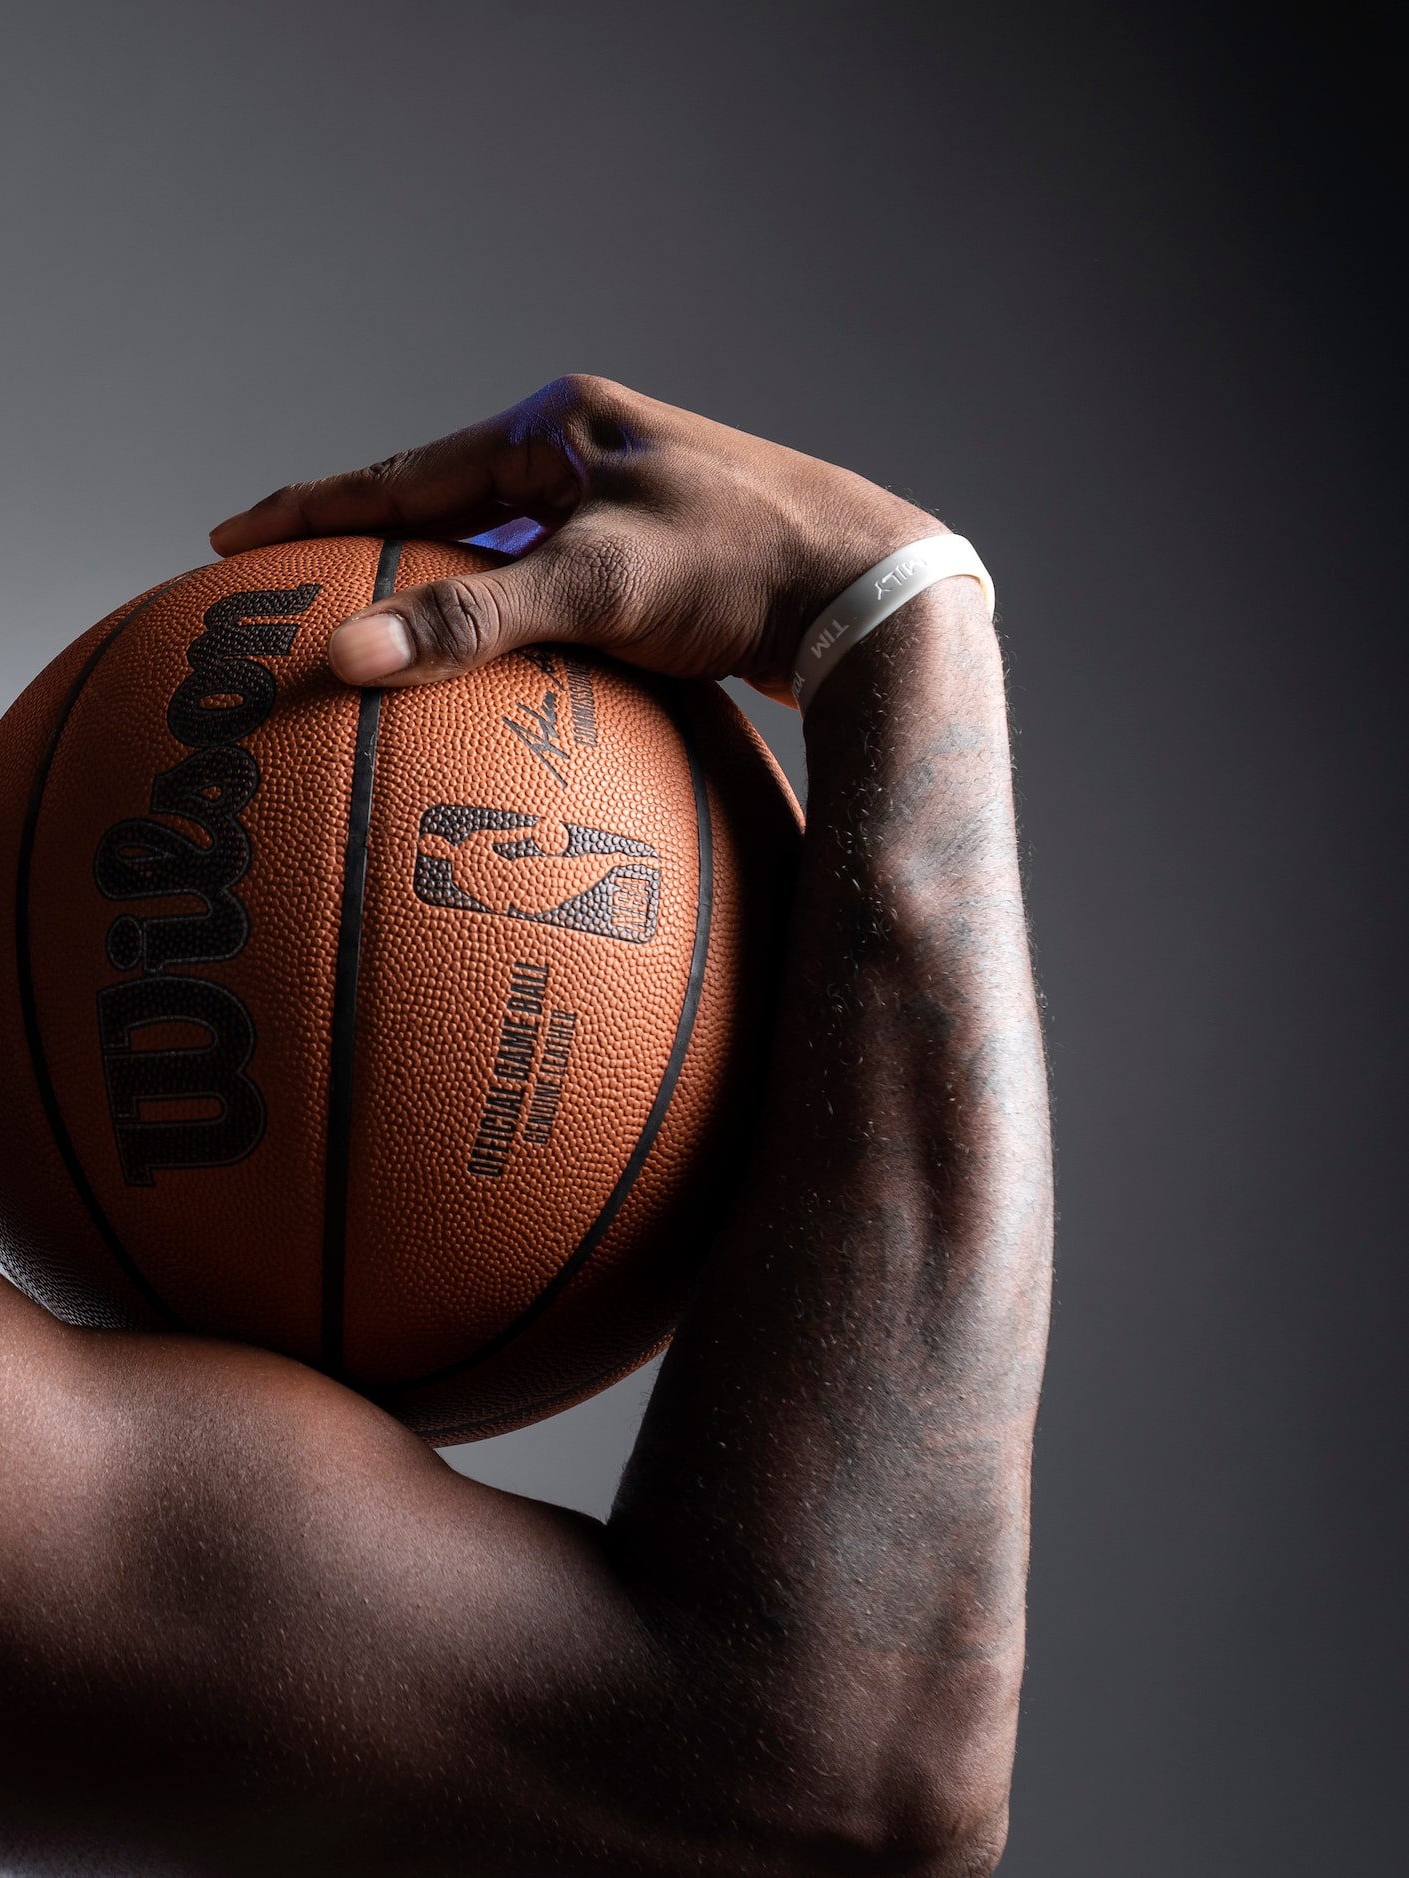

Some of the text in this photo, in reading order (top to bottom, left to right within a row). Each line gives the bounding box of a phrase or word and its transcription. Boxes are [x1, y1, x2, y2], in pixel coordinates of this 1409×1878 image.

[810, 619, 850, 659] TIM
[94, 584, 322, 1188] Wilson
[609, 876, 651, 932] NBA
[467, 962, 549, 1178] OFFICIAL GAME BALL
[523, 1009, 577, 1146] GENUINE LEATHER
